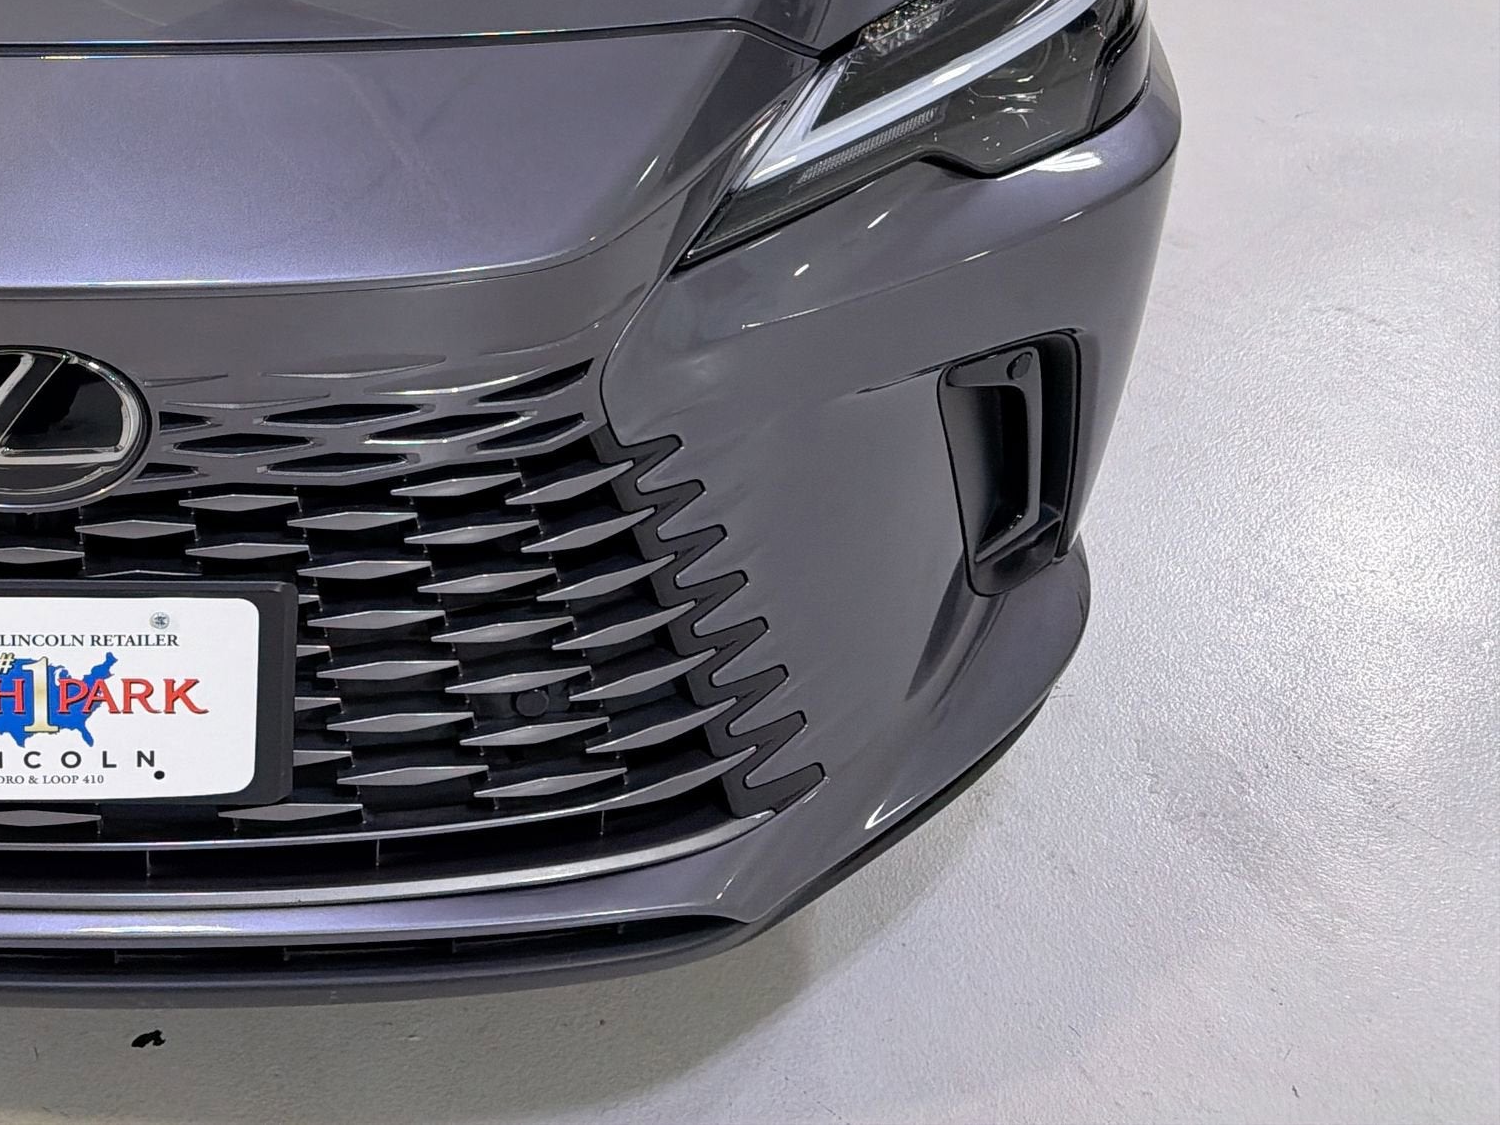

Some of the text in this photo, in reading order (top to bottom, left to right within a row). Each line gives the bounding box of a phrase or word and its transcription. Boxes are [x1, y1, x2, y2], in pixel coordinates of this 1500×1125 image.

[0, 634, 85, 647] LINCOLN
[90, 634, 180, 647] RETAILER
[57, 677, 210, 715] PARK
[28, 774, 39, 785] &
[43, 774, 80, 785] LOOP
[82, 774, 105, 785] 410
